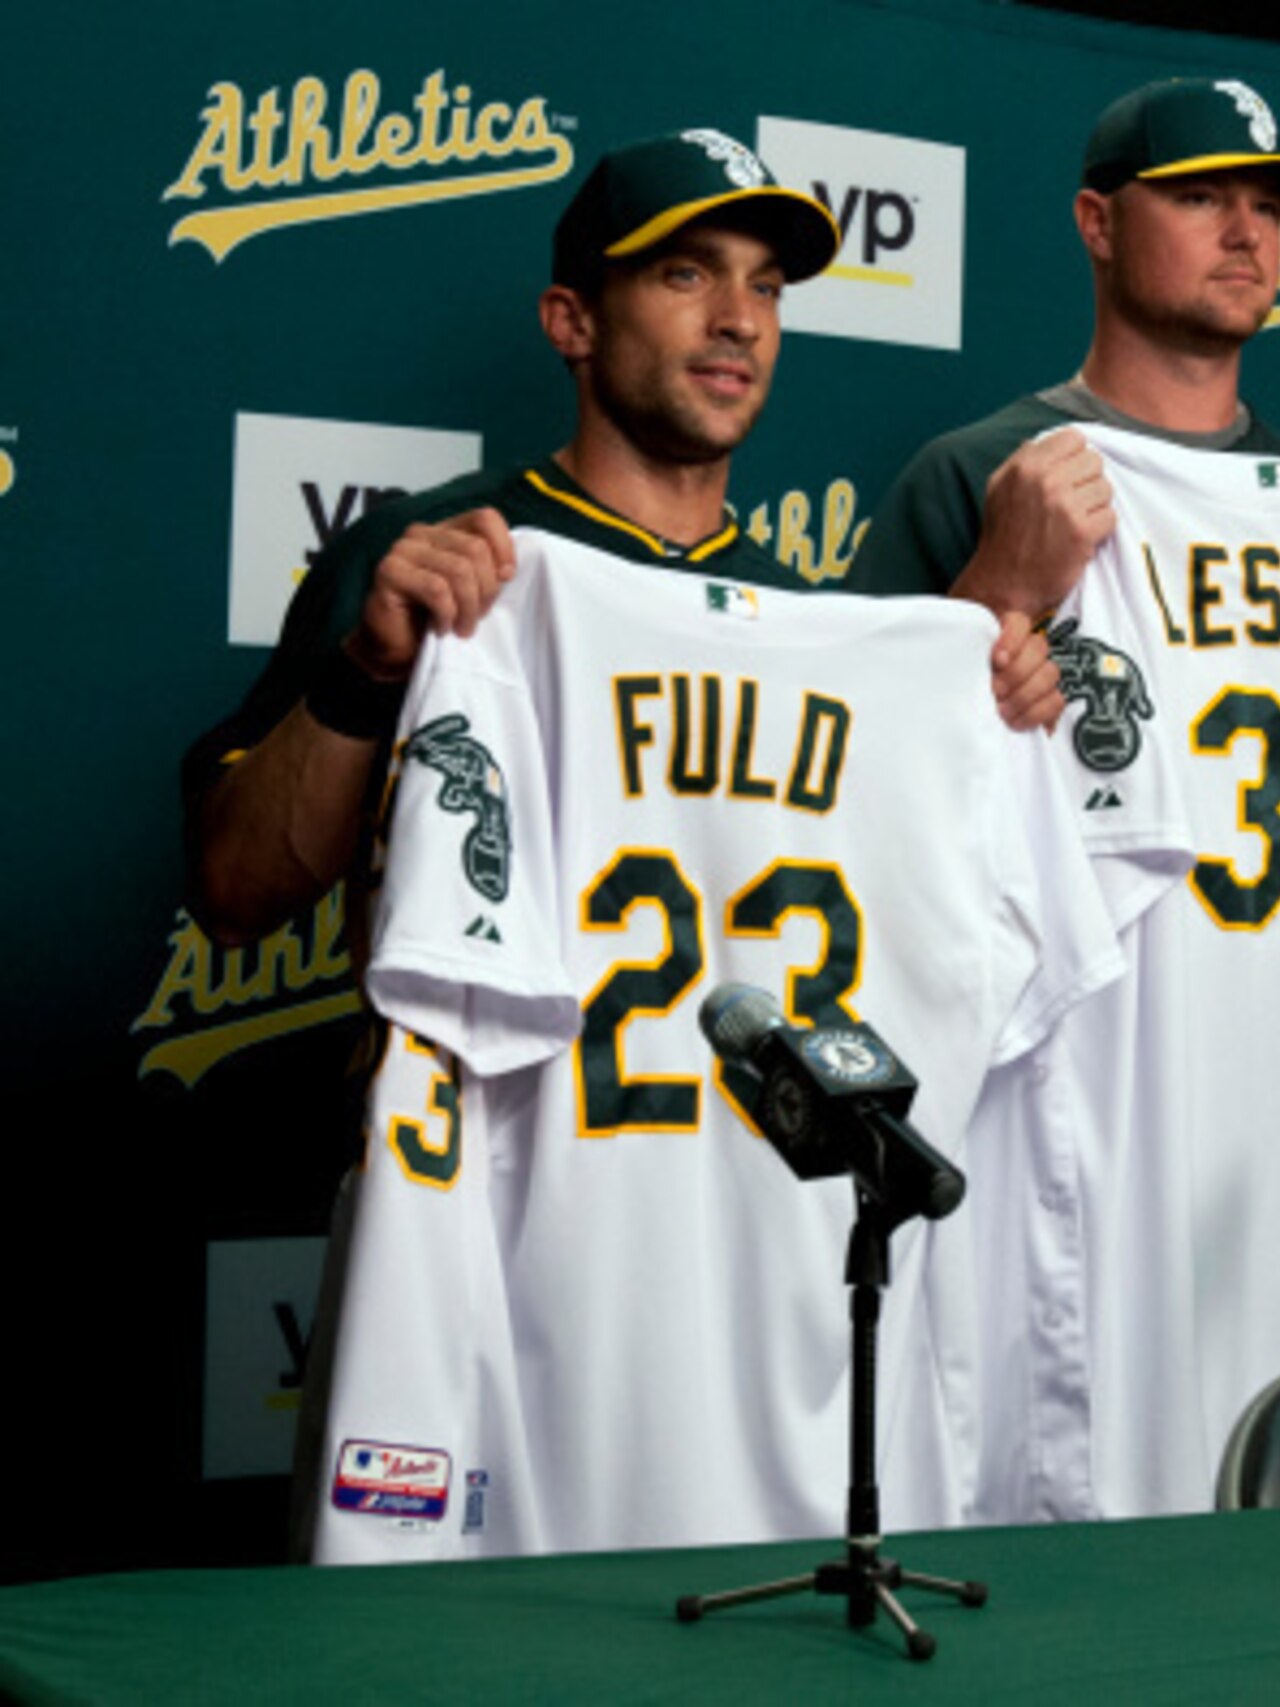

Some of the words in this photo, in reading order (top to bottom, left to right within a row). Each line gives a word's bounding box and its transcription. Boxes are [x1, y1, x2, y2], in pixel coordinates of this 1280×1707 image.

[160, 67, 560, 203] Athletics
[613, 673, 852, 816] FULD
[573, 847, 863, 1138] 23
